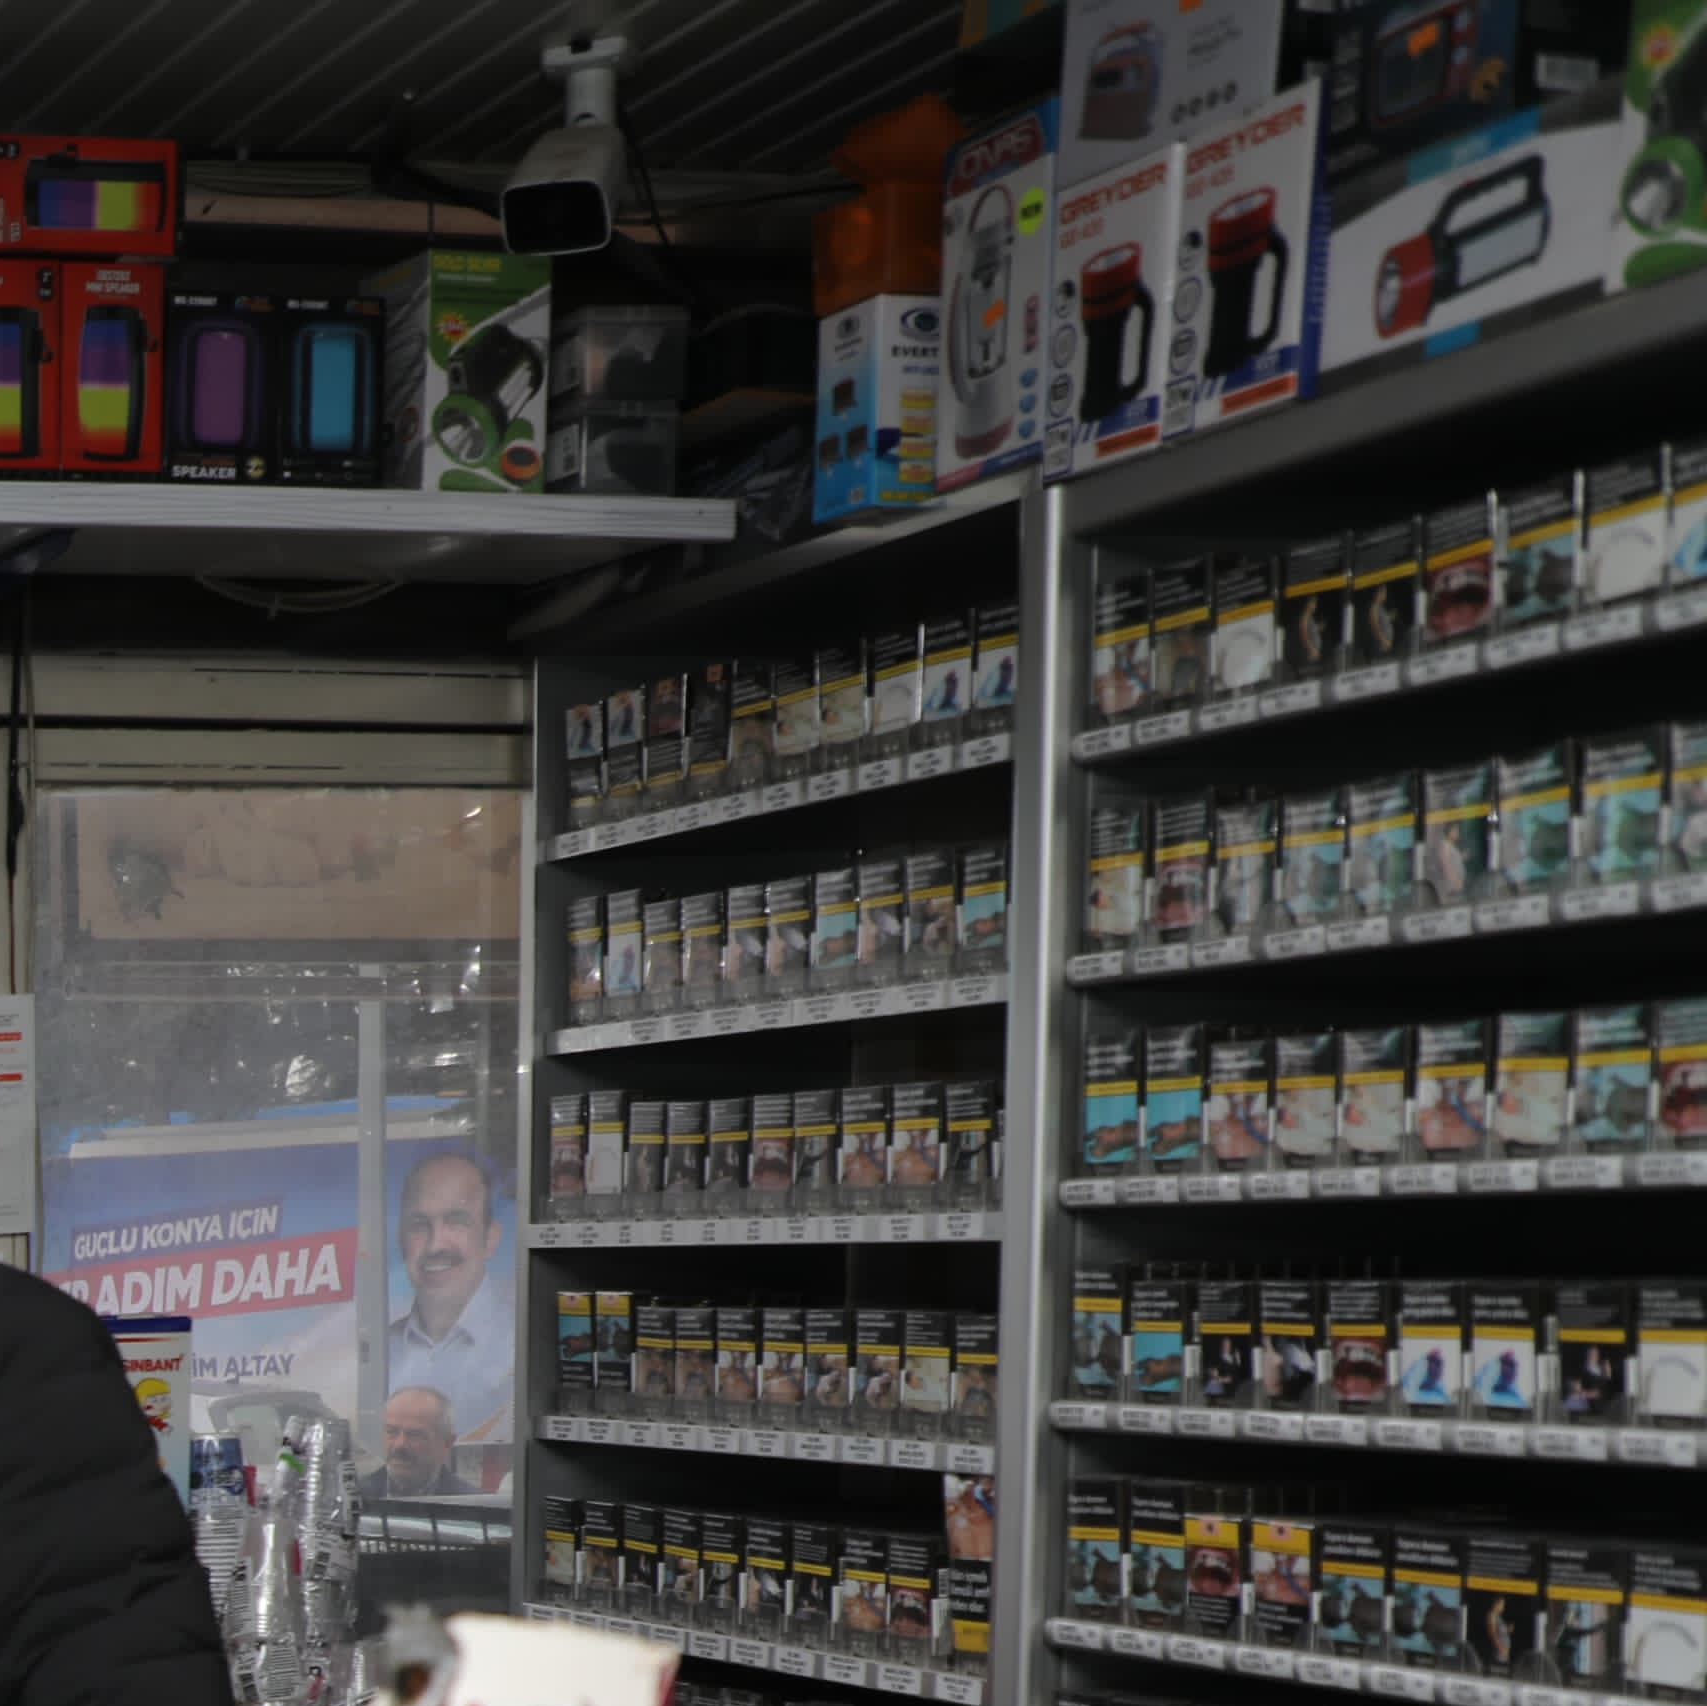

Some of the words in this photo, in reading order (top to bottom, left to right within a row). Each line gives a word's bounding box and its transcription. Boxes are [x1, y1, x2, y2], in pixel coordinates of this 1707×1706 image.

[891, 344, 939, 359] EVERT
[171, 463, 237, 481] SPEAKER
[141, 1213, 224, 1251] KONYA
[95, 1262, 204, 1318] ADIM
[210, 1242, 344, 1305] DAHA
[223, 1353, 296, 1378] ALTAY
